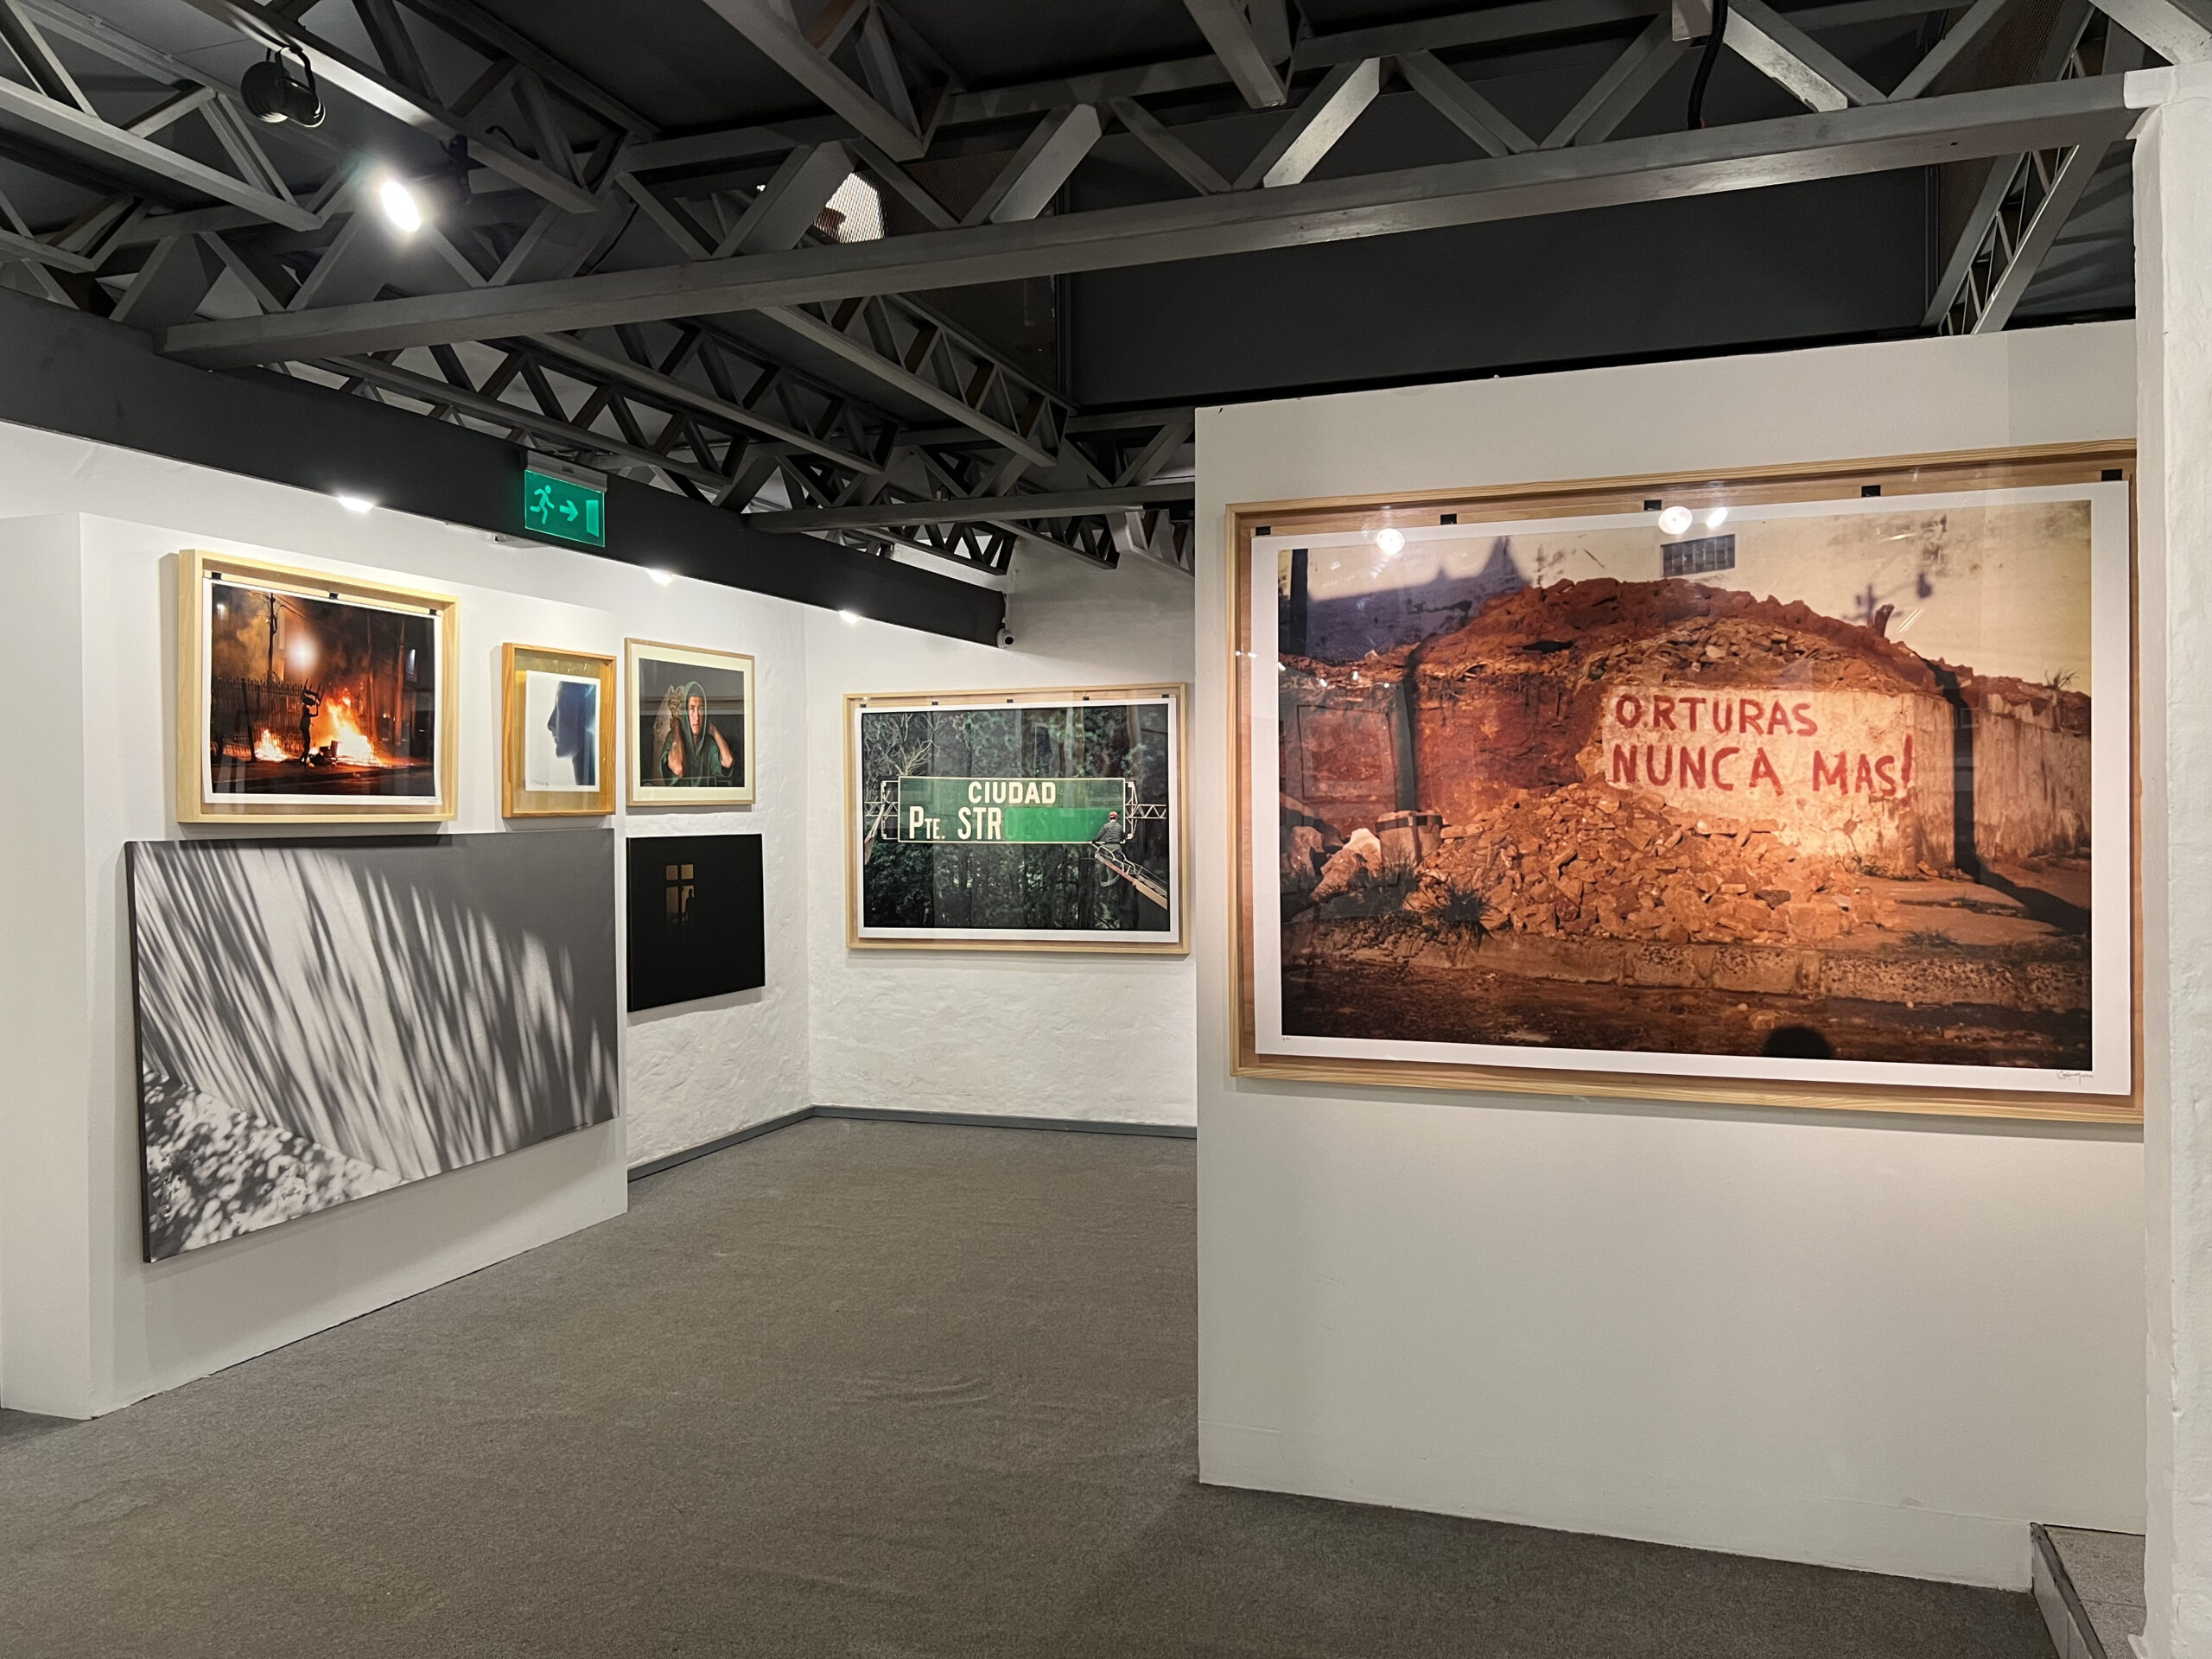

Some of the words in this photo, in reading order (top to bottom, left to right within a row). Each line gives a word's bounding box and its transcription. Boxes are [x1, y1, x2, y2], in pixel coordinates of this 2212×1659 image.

[968, 781, 1056, 804] CIUDAD
[1612, 744, 1784, 797] NUNCA
[1812, 733, 1913, 807] MAS!
